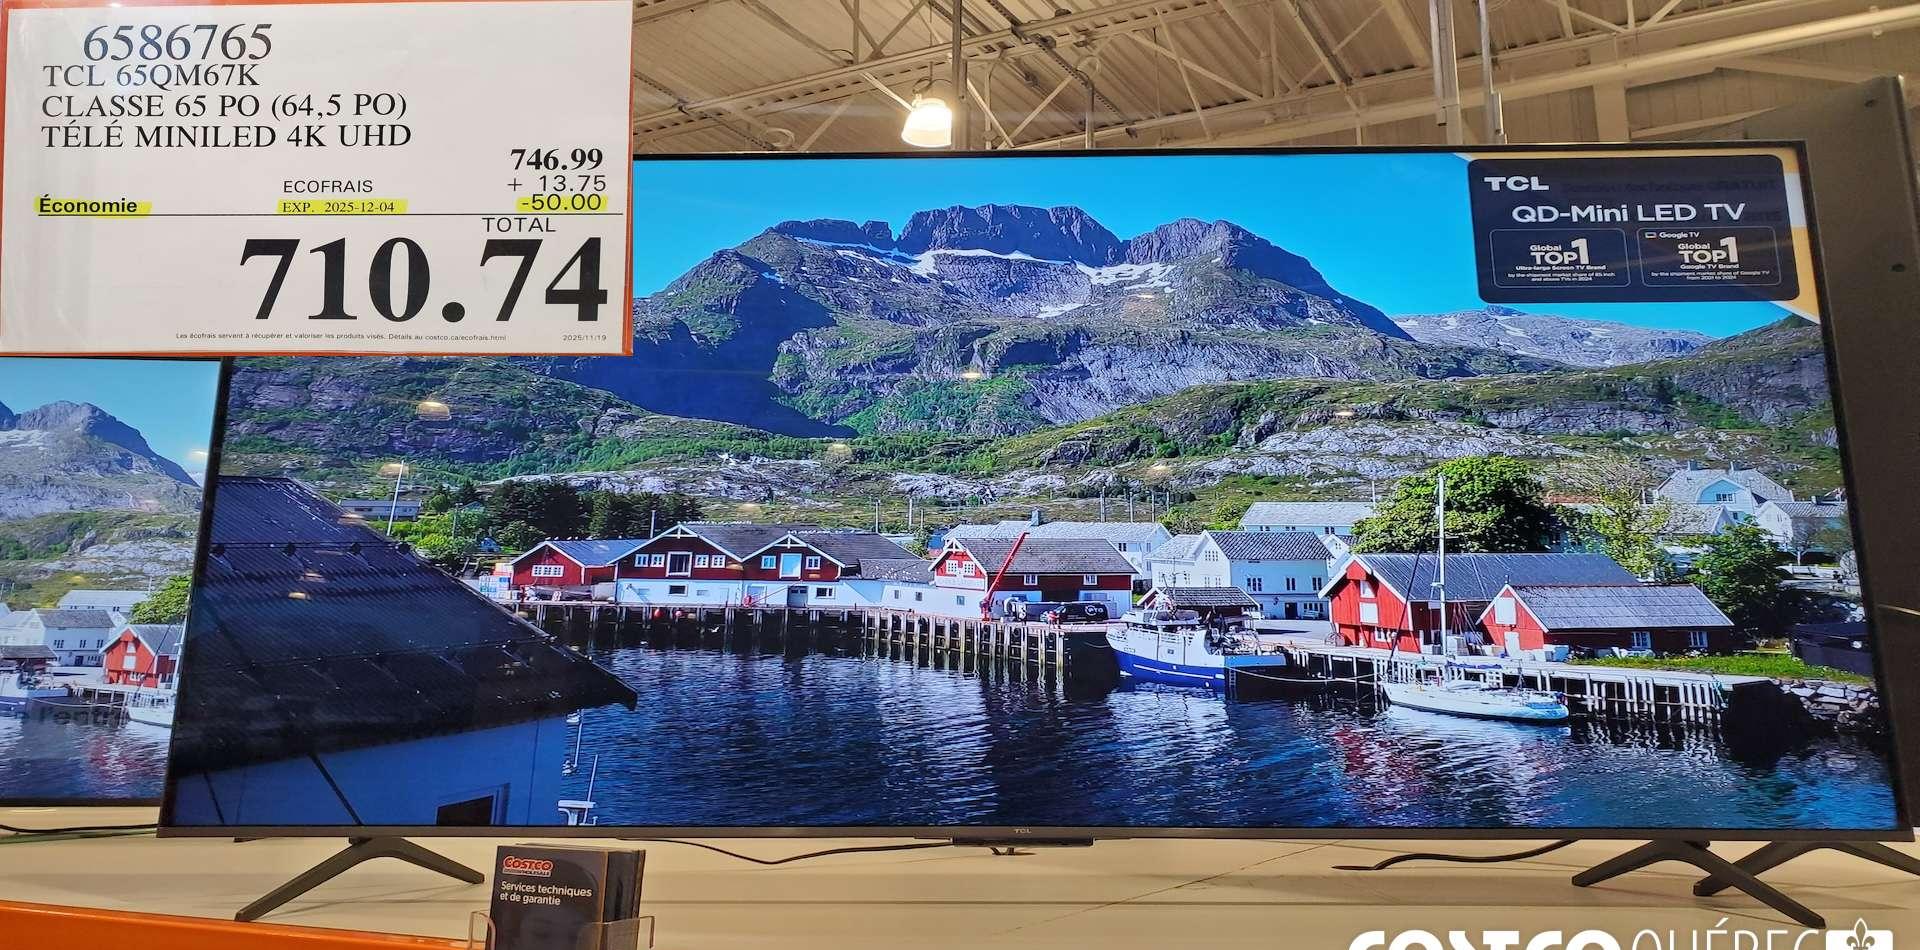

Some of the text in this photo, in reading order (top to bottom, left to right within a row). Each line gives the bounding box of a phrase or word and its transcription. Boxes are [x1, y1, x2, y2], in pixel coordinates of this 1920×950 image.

[83, 23, 272, 61] 6586765
[42, 63, 260, 91] TCL 65QM67K
[42, 91, 408, 122] CLASSE 65 PO (64,5 PO)
[41, 119, 412, 148] TÉLÉ MINILED 4K UHD
[510, 148, 603, 171] 746.99
[283, 180, 373, 193] ECOFRAIS
[539, 174, 606, 192] 13.75
[1484, 175, 1550, 192] TCL
[38, 194, 138, 214] Économie
[282, 202, 395, 213] EXP. 2025-12-04
[522, 193, 602, 211] -50.00
[1511, 203, 1629, 224] QD-Mini
[1637, 204, 1697, 223] LED
[1702, 202, 1746, 222] TV
[481, 217, 557, 233] TOTAL
[1659, 231, 1688, 239] Google
[1529, 244, 1562, 252] Global
[1678, 242, 1710, 250] Global
[240, 236, 608, 323] 710.74
[175, 332, 188, 340] Les
[189, 332, 216, 340] écofrais
[251, 332, 283, 341] récupérer
[285, 332, 292, 340] et
[294, 332, 323, 340] valoriser
[336, 332, 364, 341] produits
[388, 333, 412, 341] Détails
[503, 856, 554, 871] COSTCO
[501, 880, 593, 898] Services techniques
[500, 892, 561, 906] et de garantie
